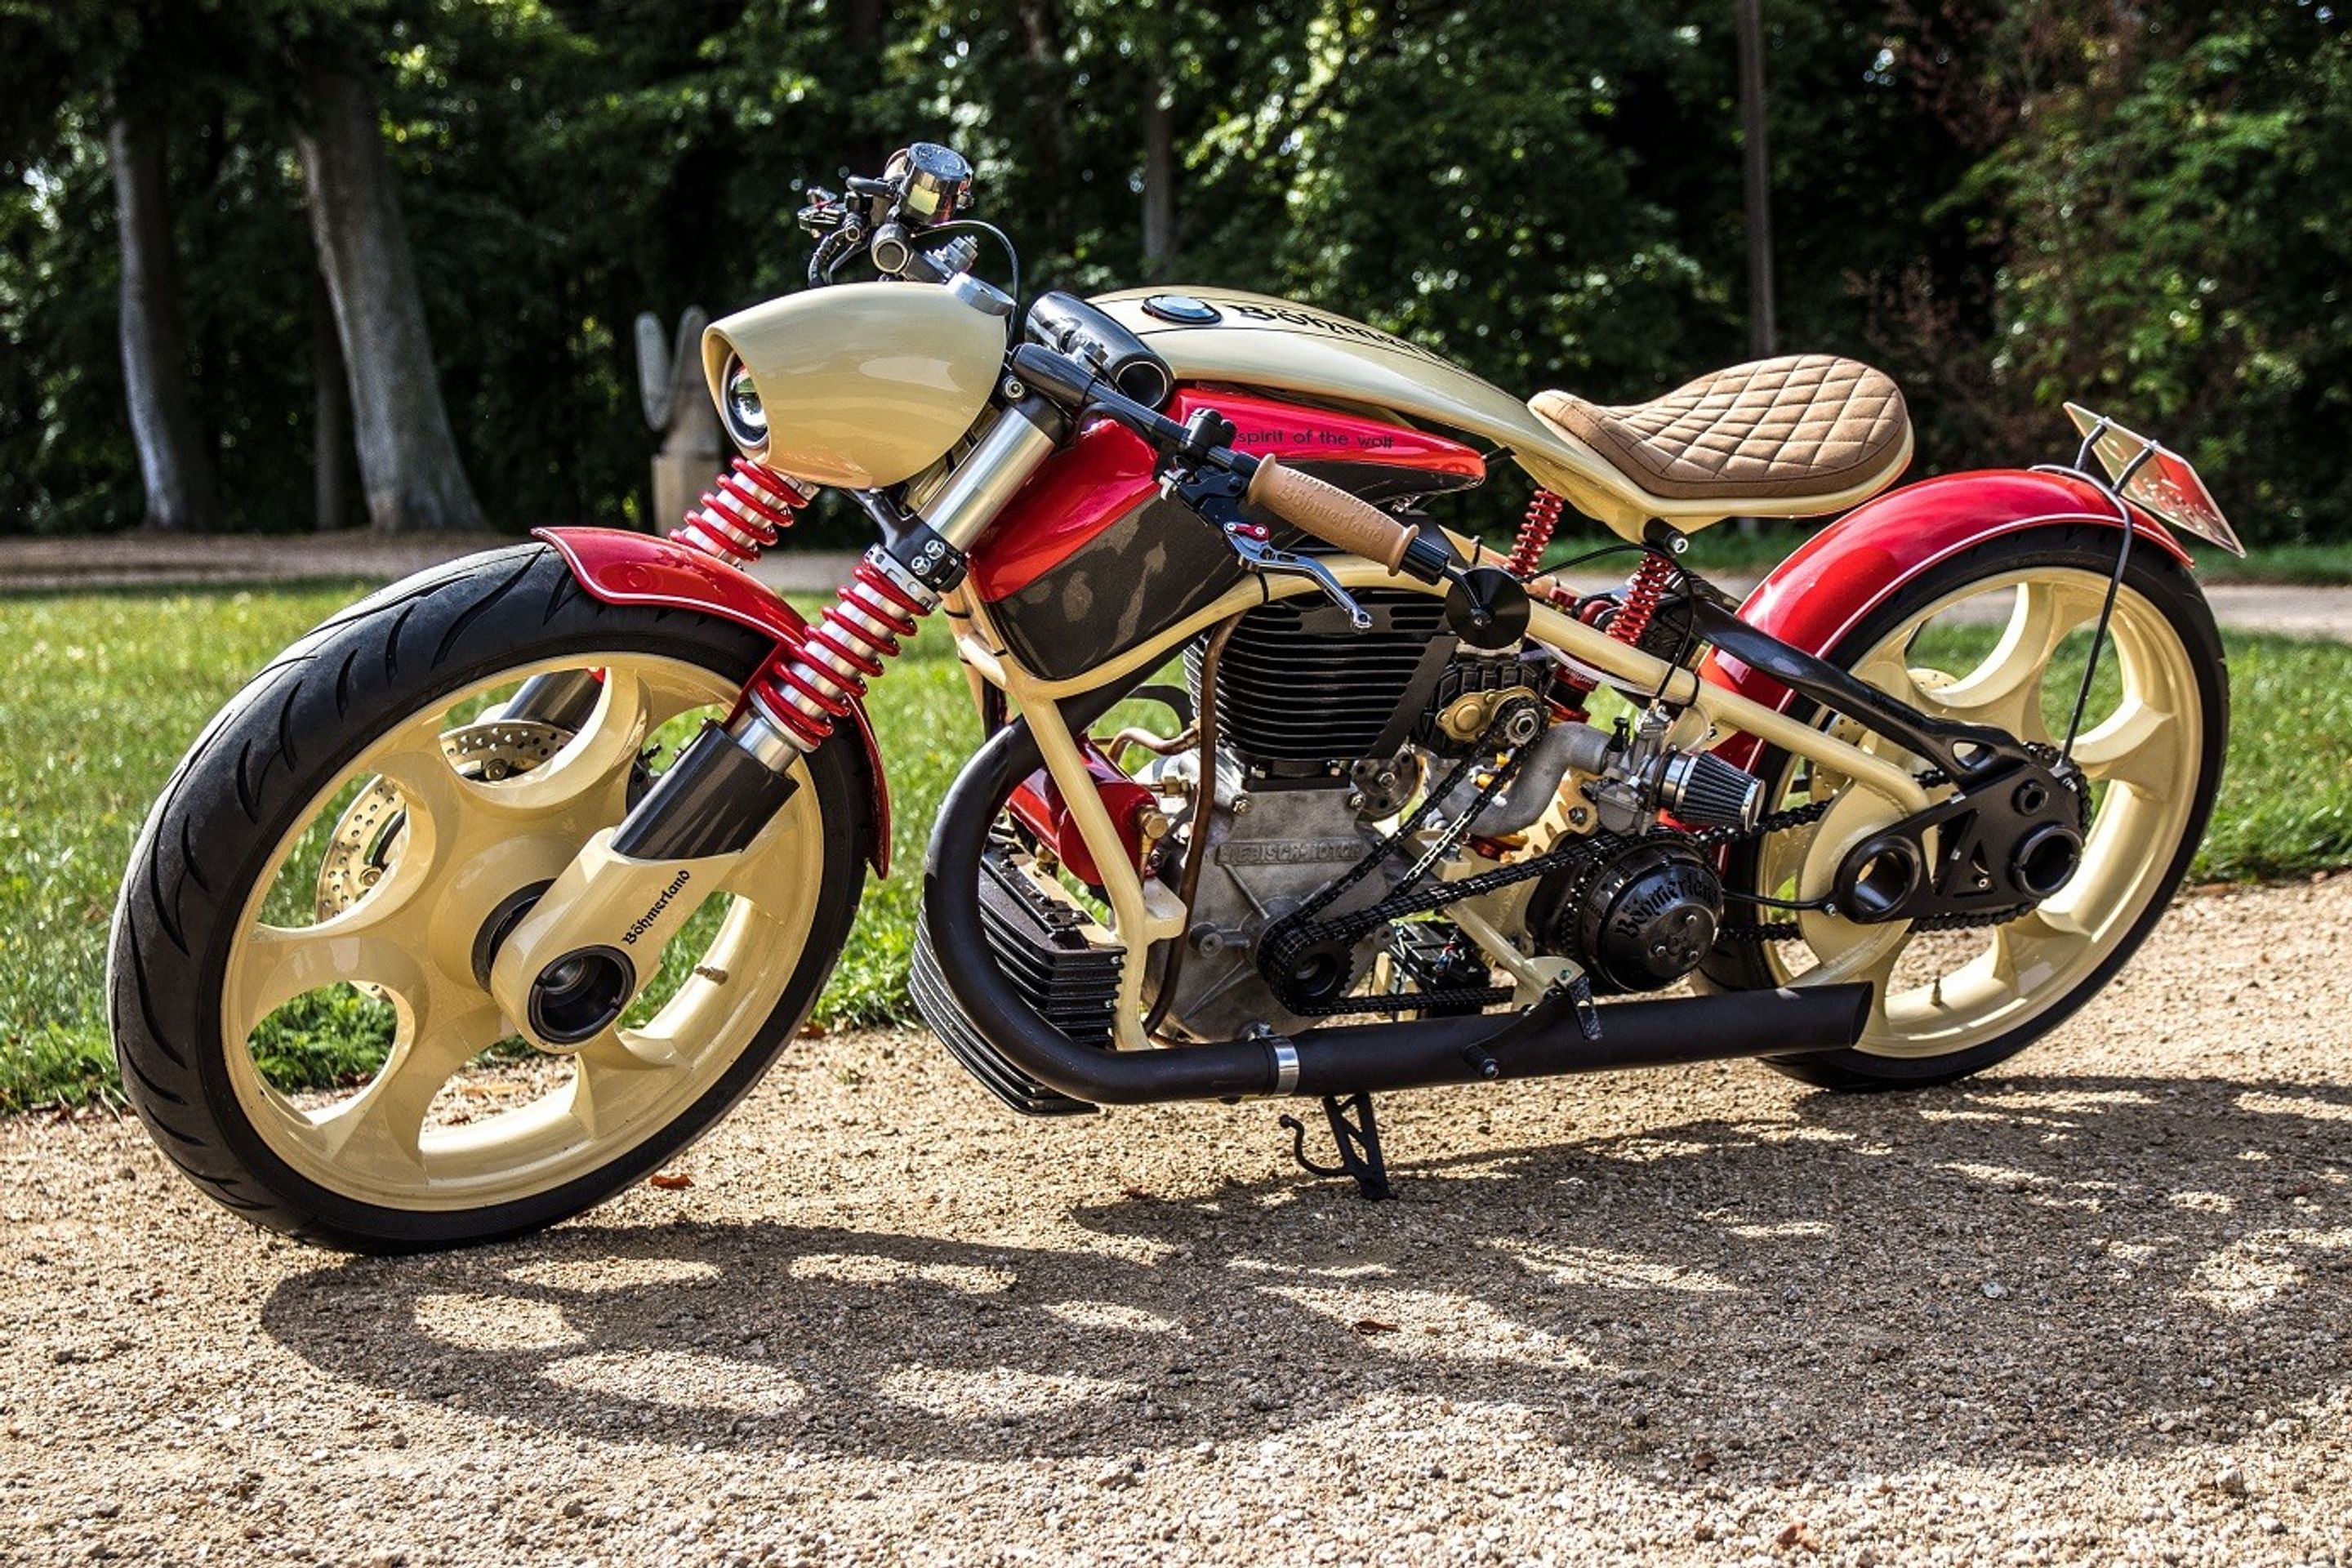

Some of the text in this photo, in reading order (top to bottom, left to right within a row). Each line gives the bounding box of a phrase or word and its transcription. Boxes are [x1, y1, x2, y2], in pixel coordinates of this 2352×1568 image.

[1238, 430, 1395, 449] spirit of the wolf
[621, 869, 690, 945] Böhmerland
